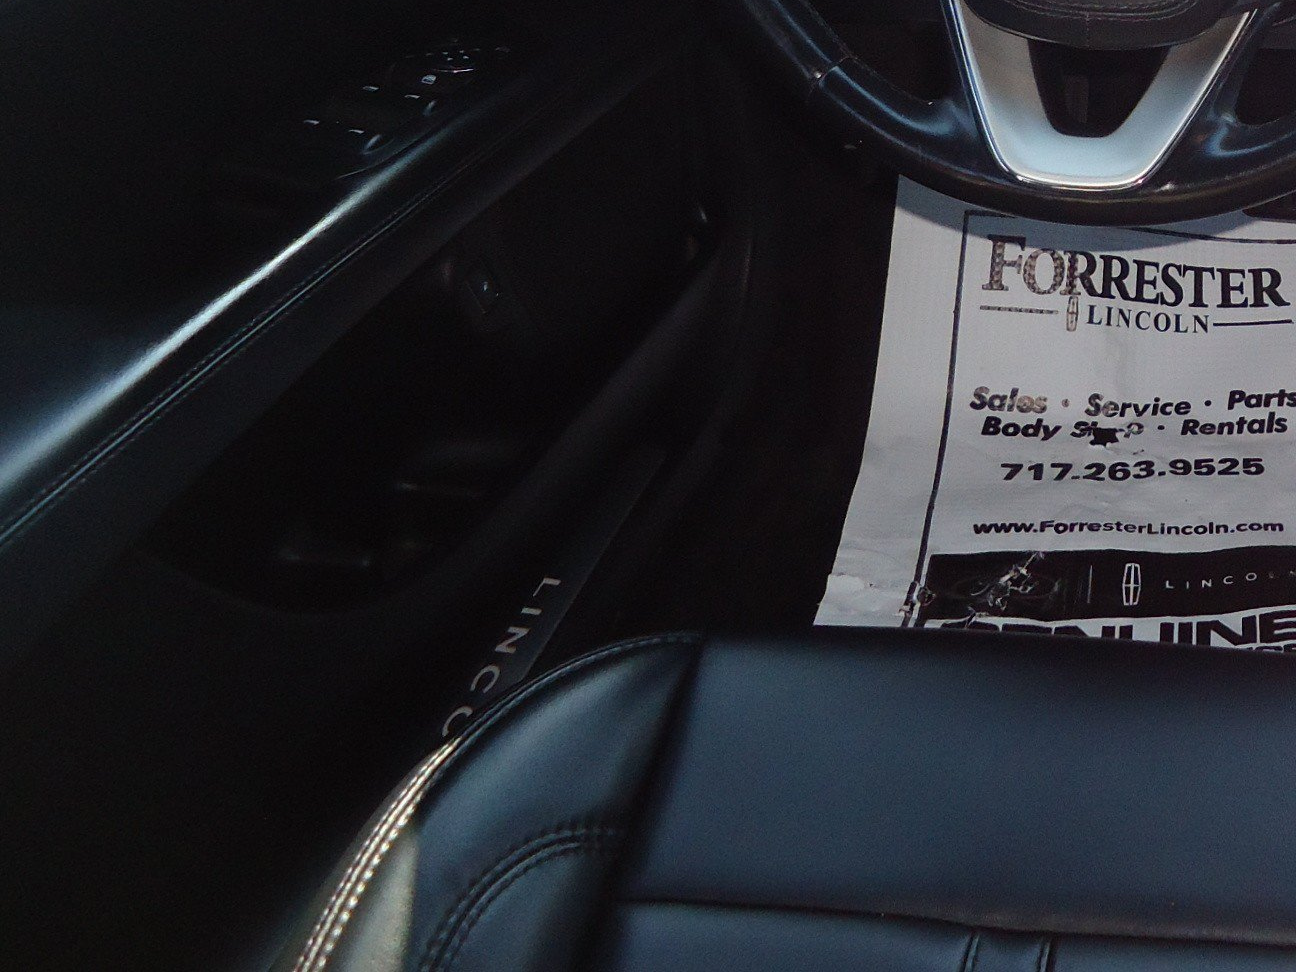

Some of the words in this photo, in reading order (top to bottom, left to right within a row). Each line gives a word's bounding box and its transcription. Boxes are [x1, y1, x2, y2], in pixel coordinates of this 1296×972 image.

[981, 233, 1291, 308] FORRESTER
[1086, 304, 1210, 334] LINCOLN
[969, 385, 1048, 413] Sales
[1084, 392, 1192, 418] Service
[981, 415, 1062, 441] Body
[1069, 420, 1145, 439] Sp
[1180, 411, 1289, 436] Rentals
[1000, 456, 1266, 481] 717.263.9525
[973, 519, 1285, 535] www.ForresterLincoln.com
